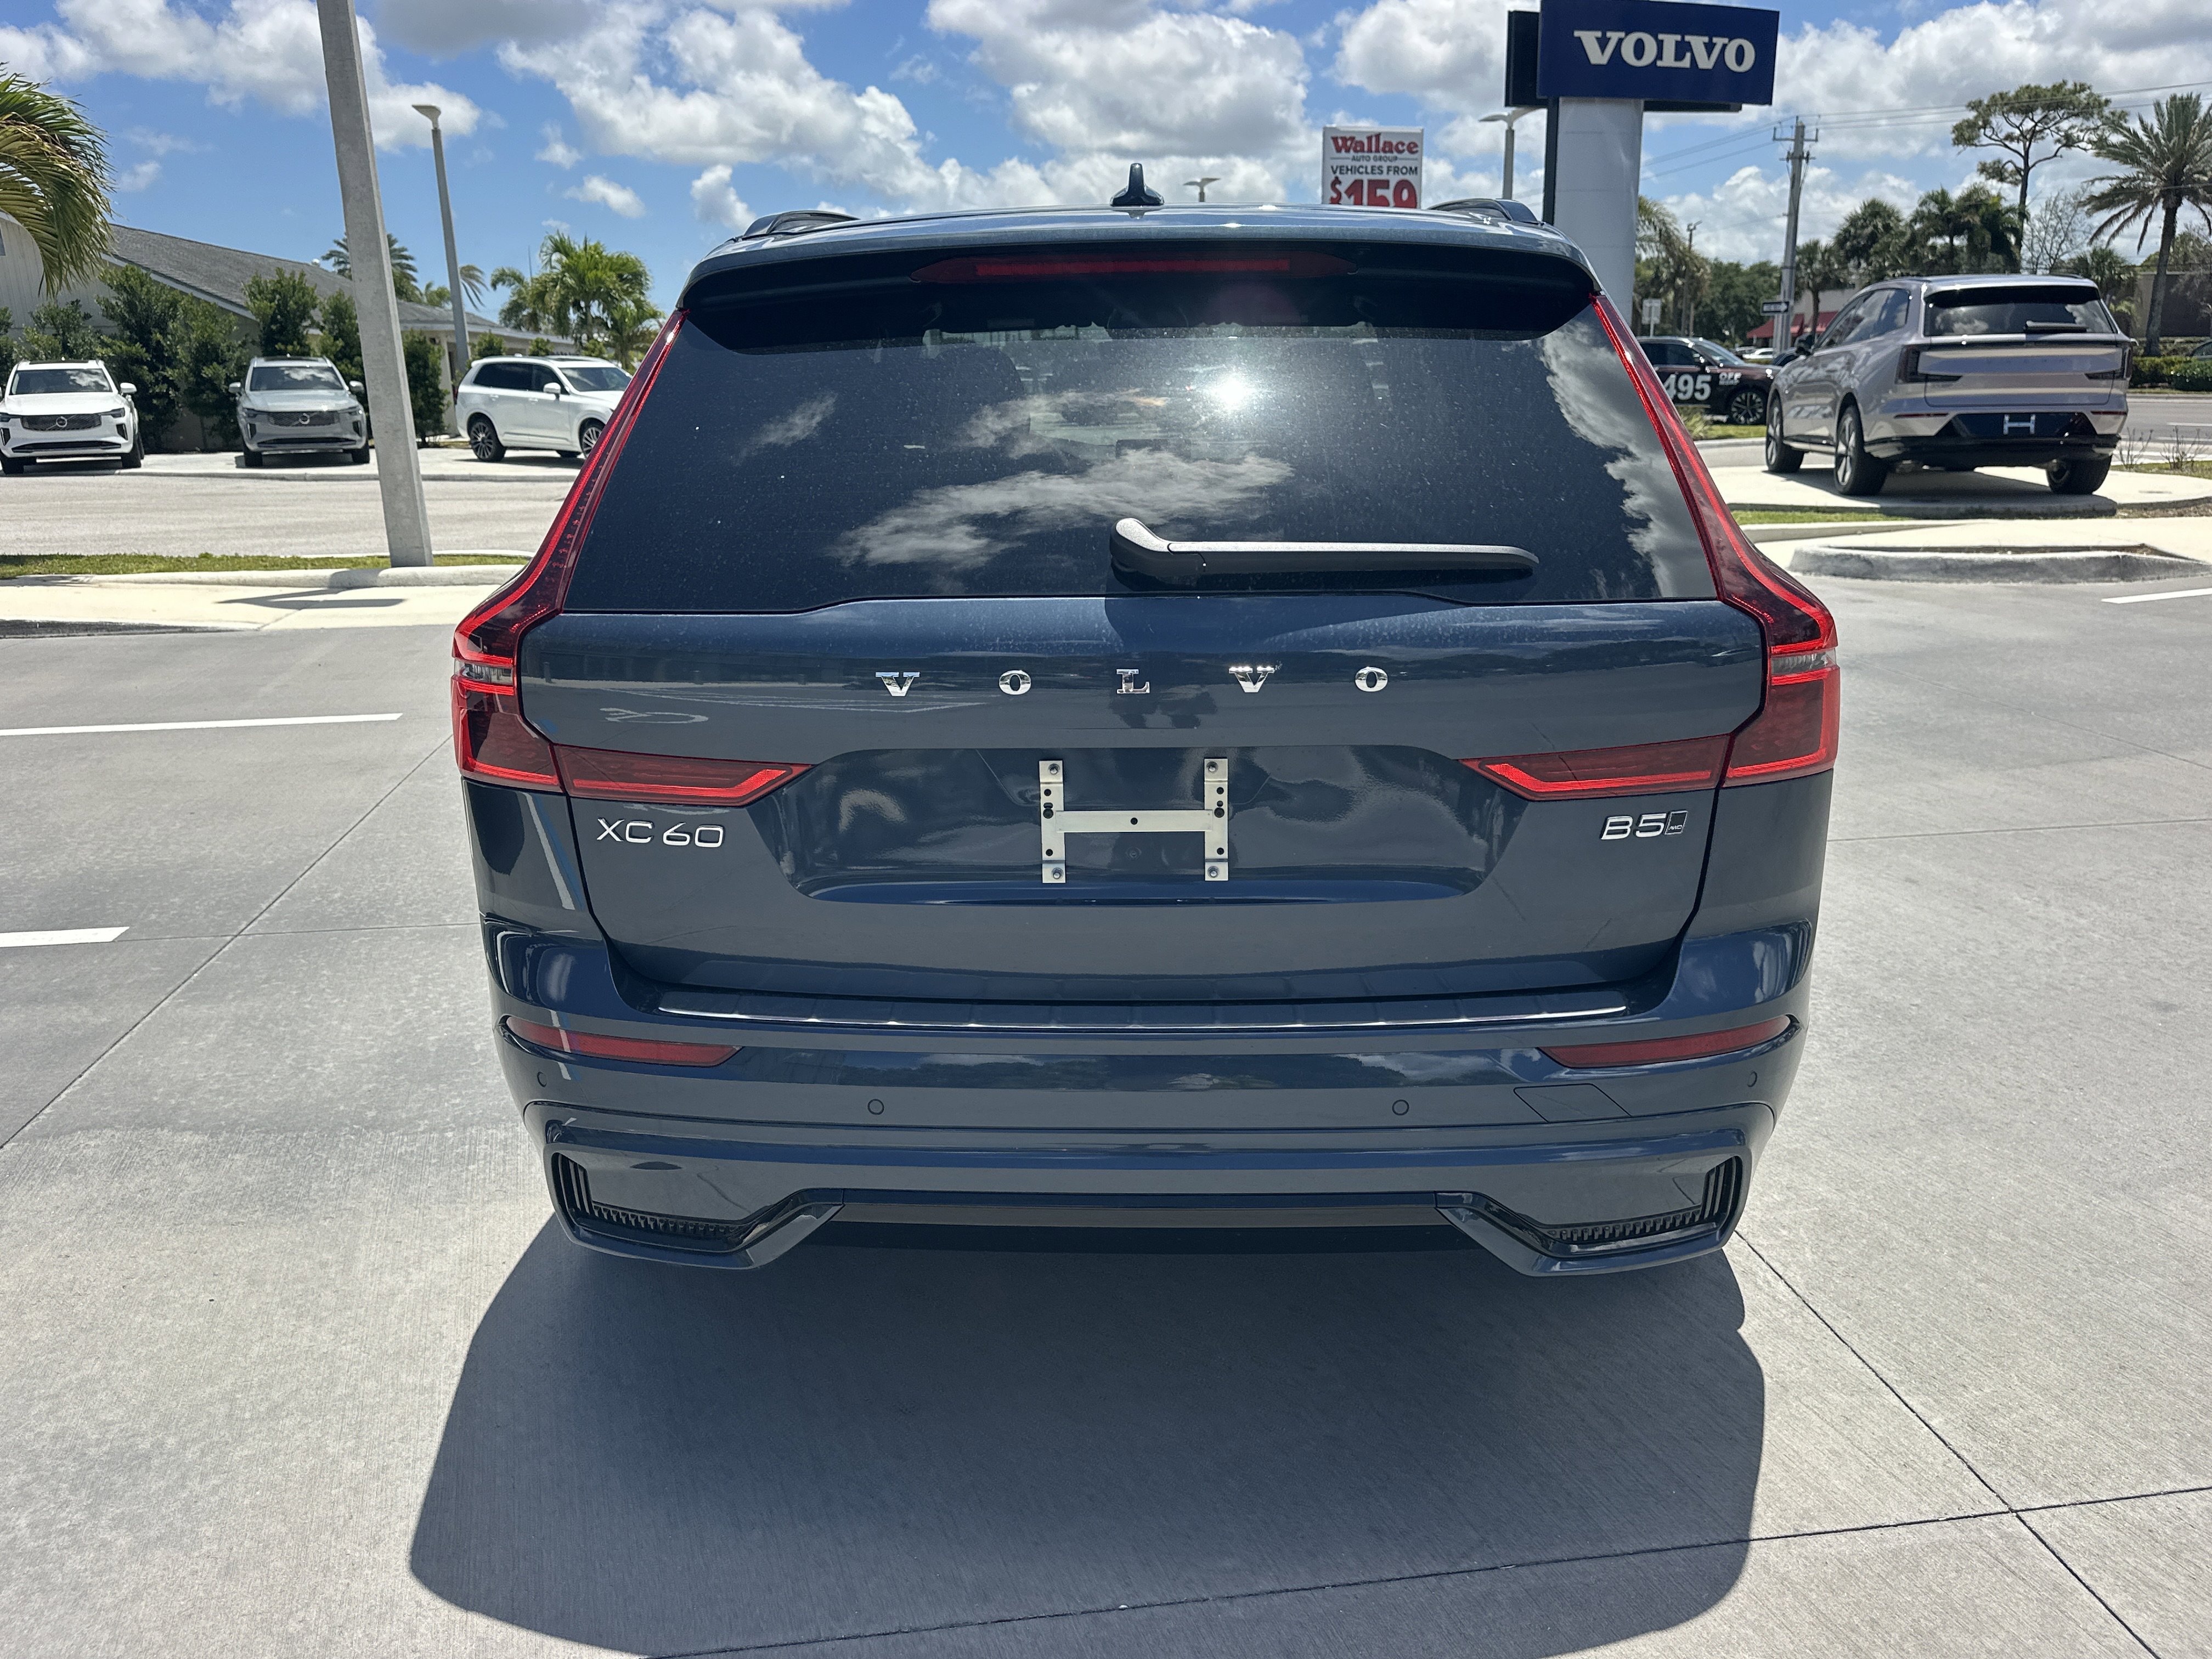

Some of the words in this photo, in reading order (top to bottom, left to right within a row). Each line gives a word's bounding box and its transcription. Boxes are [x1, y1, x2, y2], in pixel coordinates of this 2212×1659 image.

[1573, 30, 1756, 73] VOLVO
[1331, 133, 1419, 154] Wallace
[1331, 165, 1384, 175] VEHICLES
[1386, 166, 1418, 176] FROM
[875, 665, 1389, 697] VOLVO
[1601, 812, 1667, 840] B5
